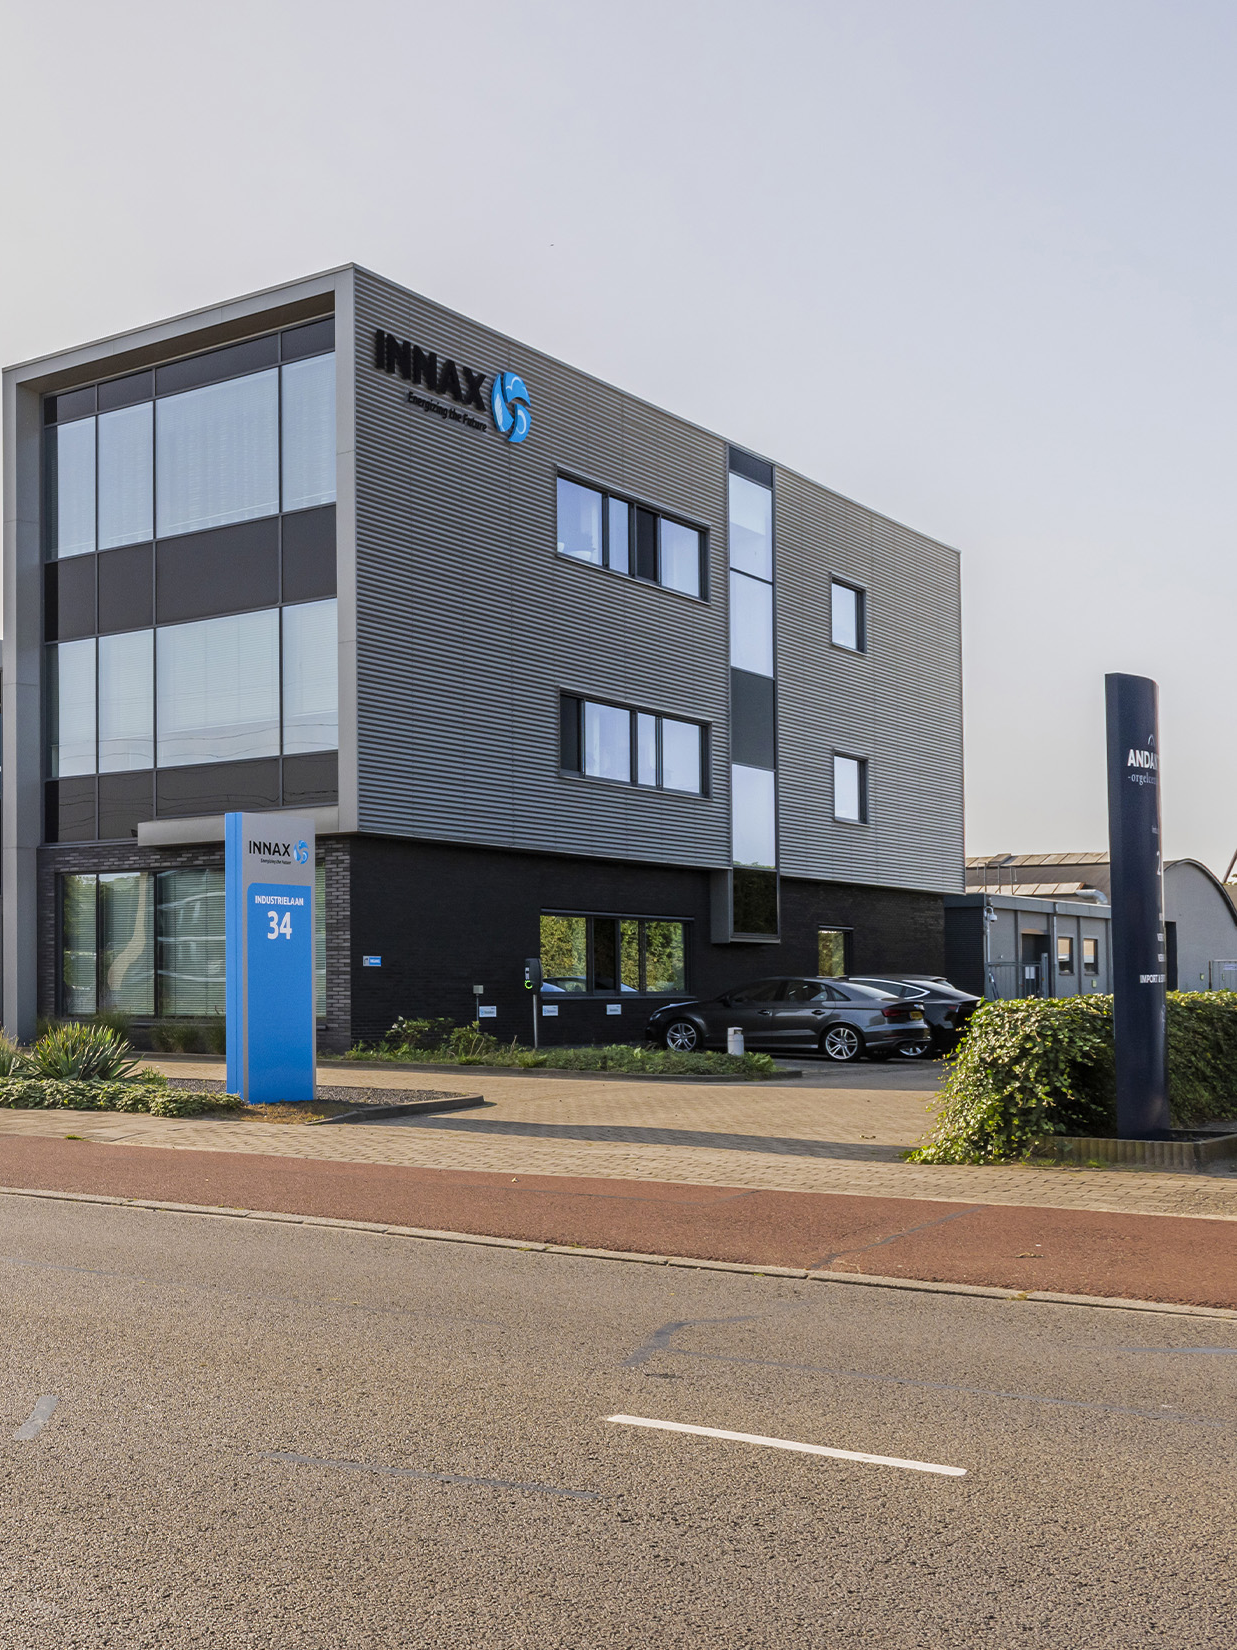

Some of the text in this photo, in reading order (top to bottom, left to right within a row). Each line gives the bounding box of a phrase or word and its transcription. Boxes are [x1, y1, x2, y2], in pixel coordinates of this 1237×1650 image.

[374, 328, 487, 412] INNAX
[408, 391, 487, 433] Energizing the Future
[248, 840, 291, 857] INNAX
[255, 895, 304, 906] INDUSTRIELAAN
[267, 910, 293, 940] 34
